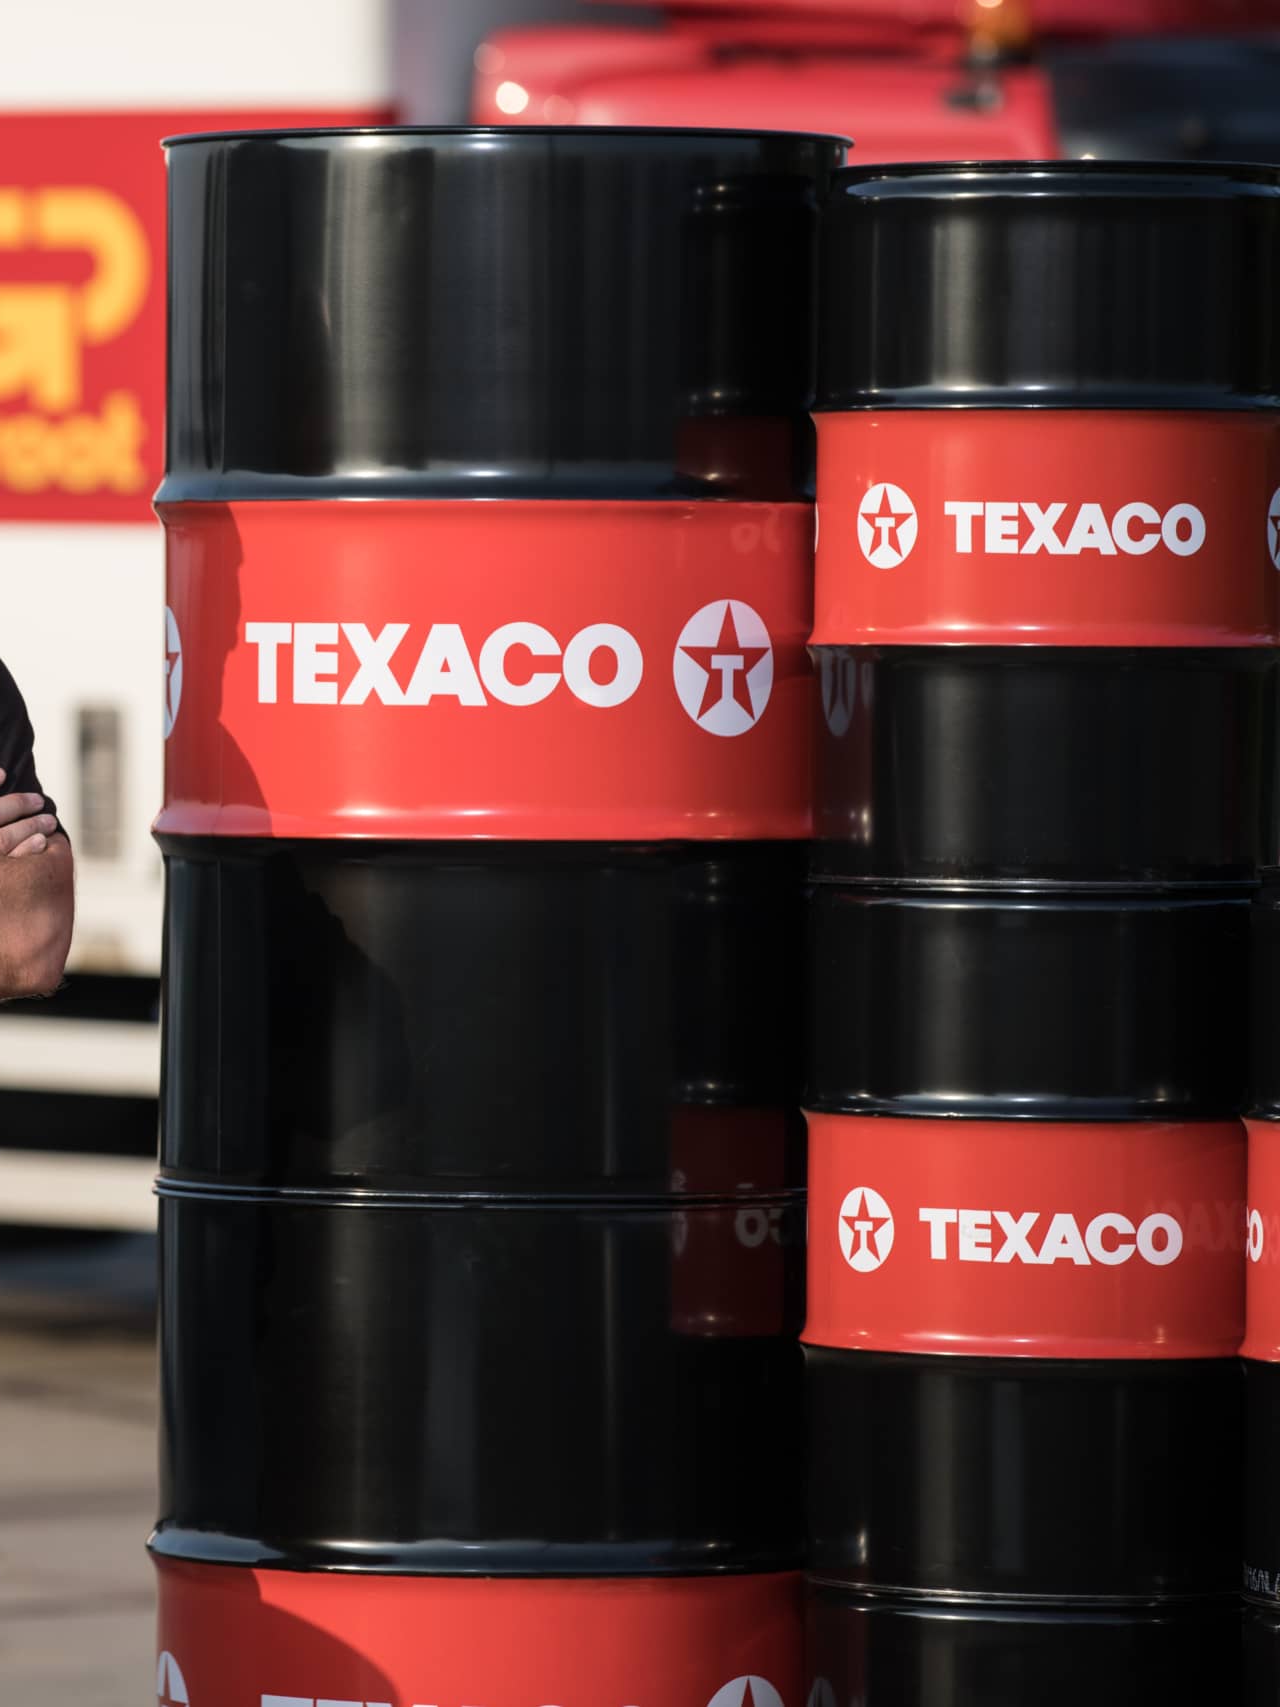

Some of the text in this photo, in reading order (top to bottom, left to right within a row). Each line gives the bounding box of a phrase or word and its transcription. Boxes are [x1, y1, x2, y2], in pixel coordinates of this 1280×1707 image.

[944, 501, 1206, 556] TEXACO
[245, 621, 644, 708] TEXACO
[919, 1207, 1183, 1266] TEXACO
